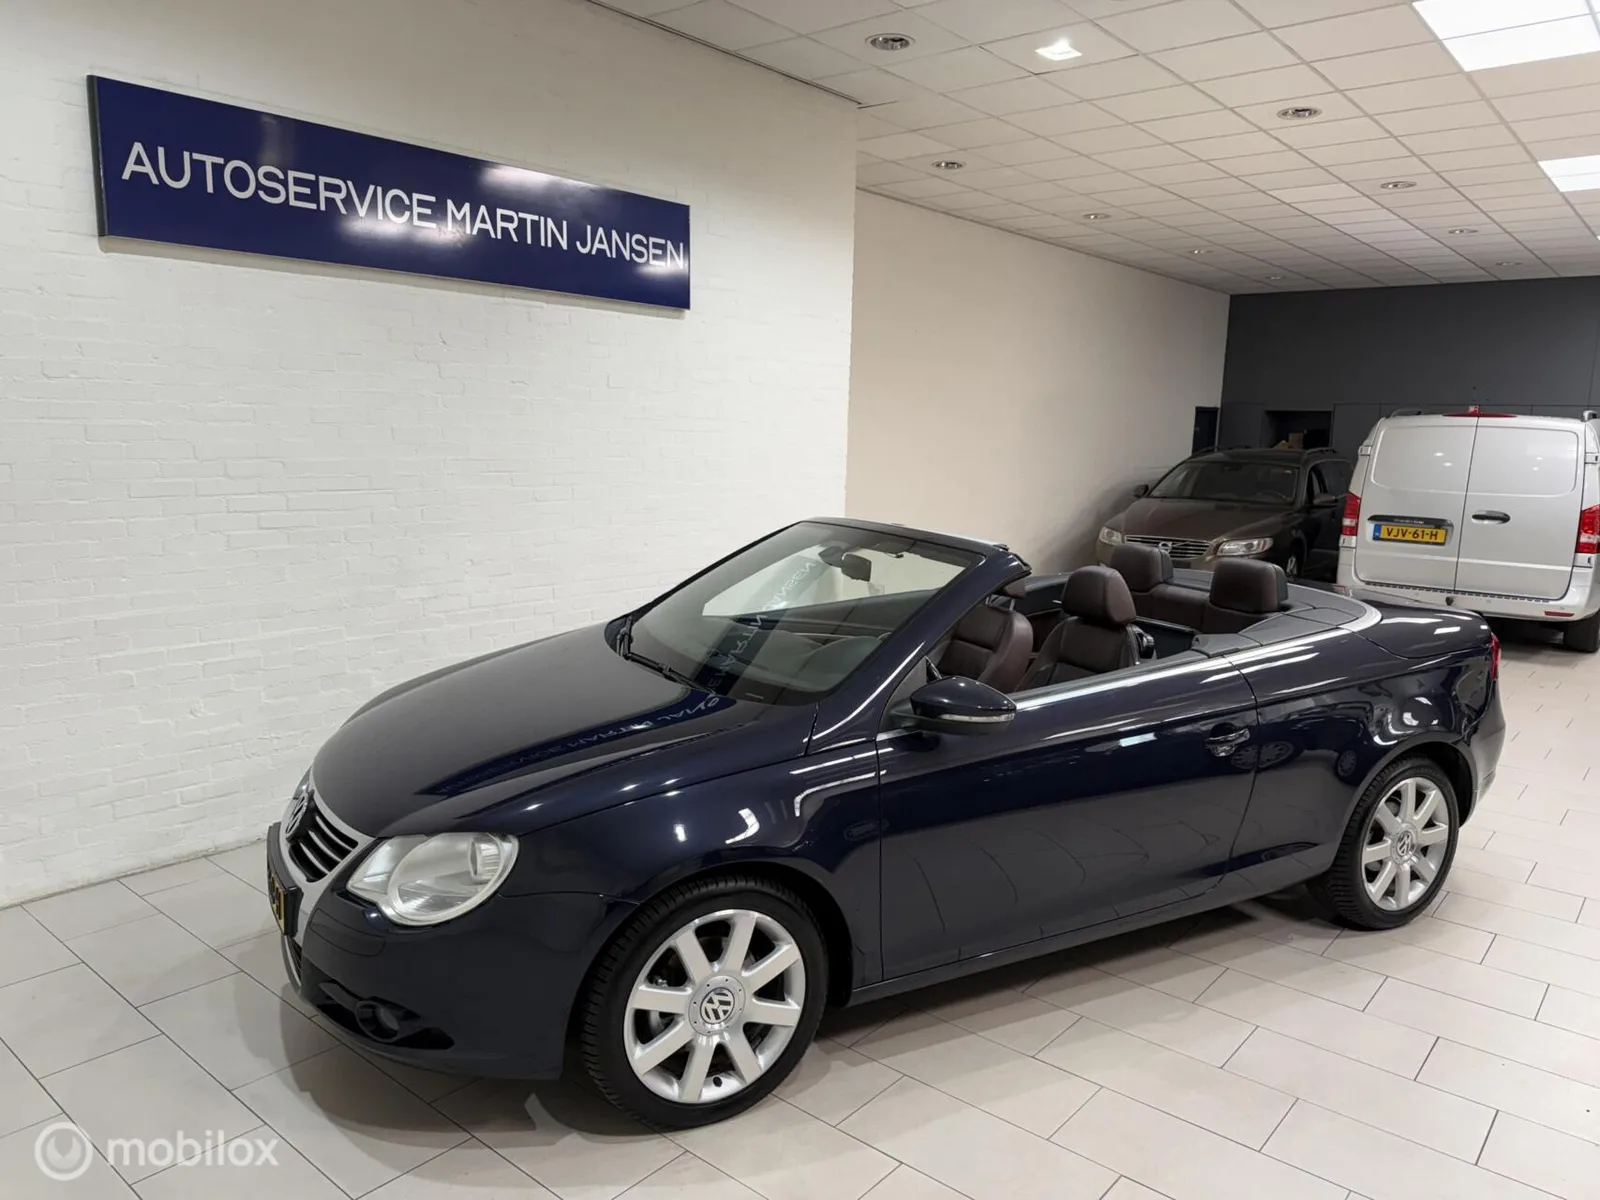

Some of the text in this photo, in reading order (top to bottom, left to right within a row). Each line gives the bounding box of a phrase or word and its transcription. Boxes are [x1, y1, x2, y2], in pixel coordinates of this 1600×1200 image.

[121, 141, 685, 270] AUTOSERVICE MARTIN JANSEN
[1386, 527, 1438, 540] VJV-61-H
